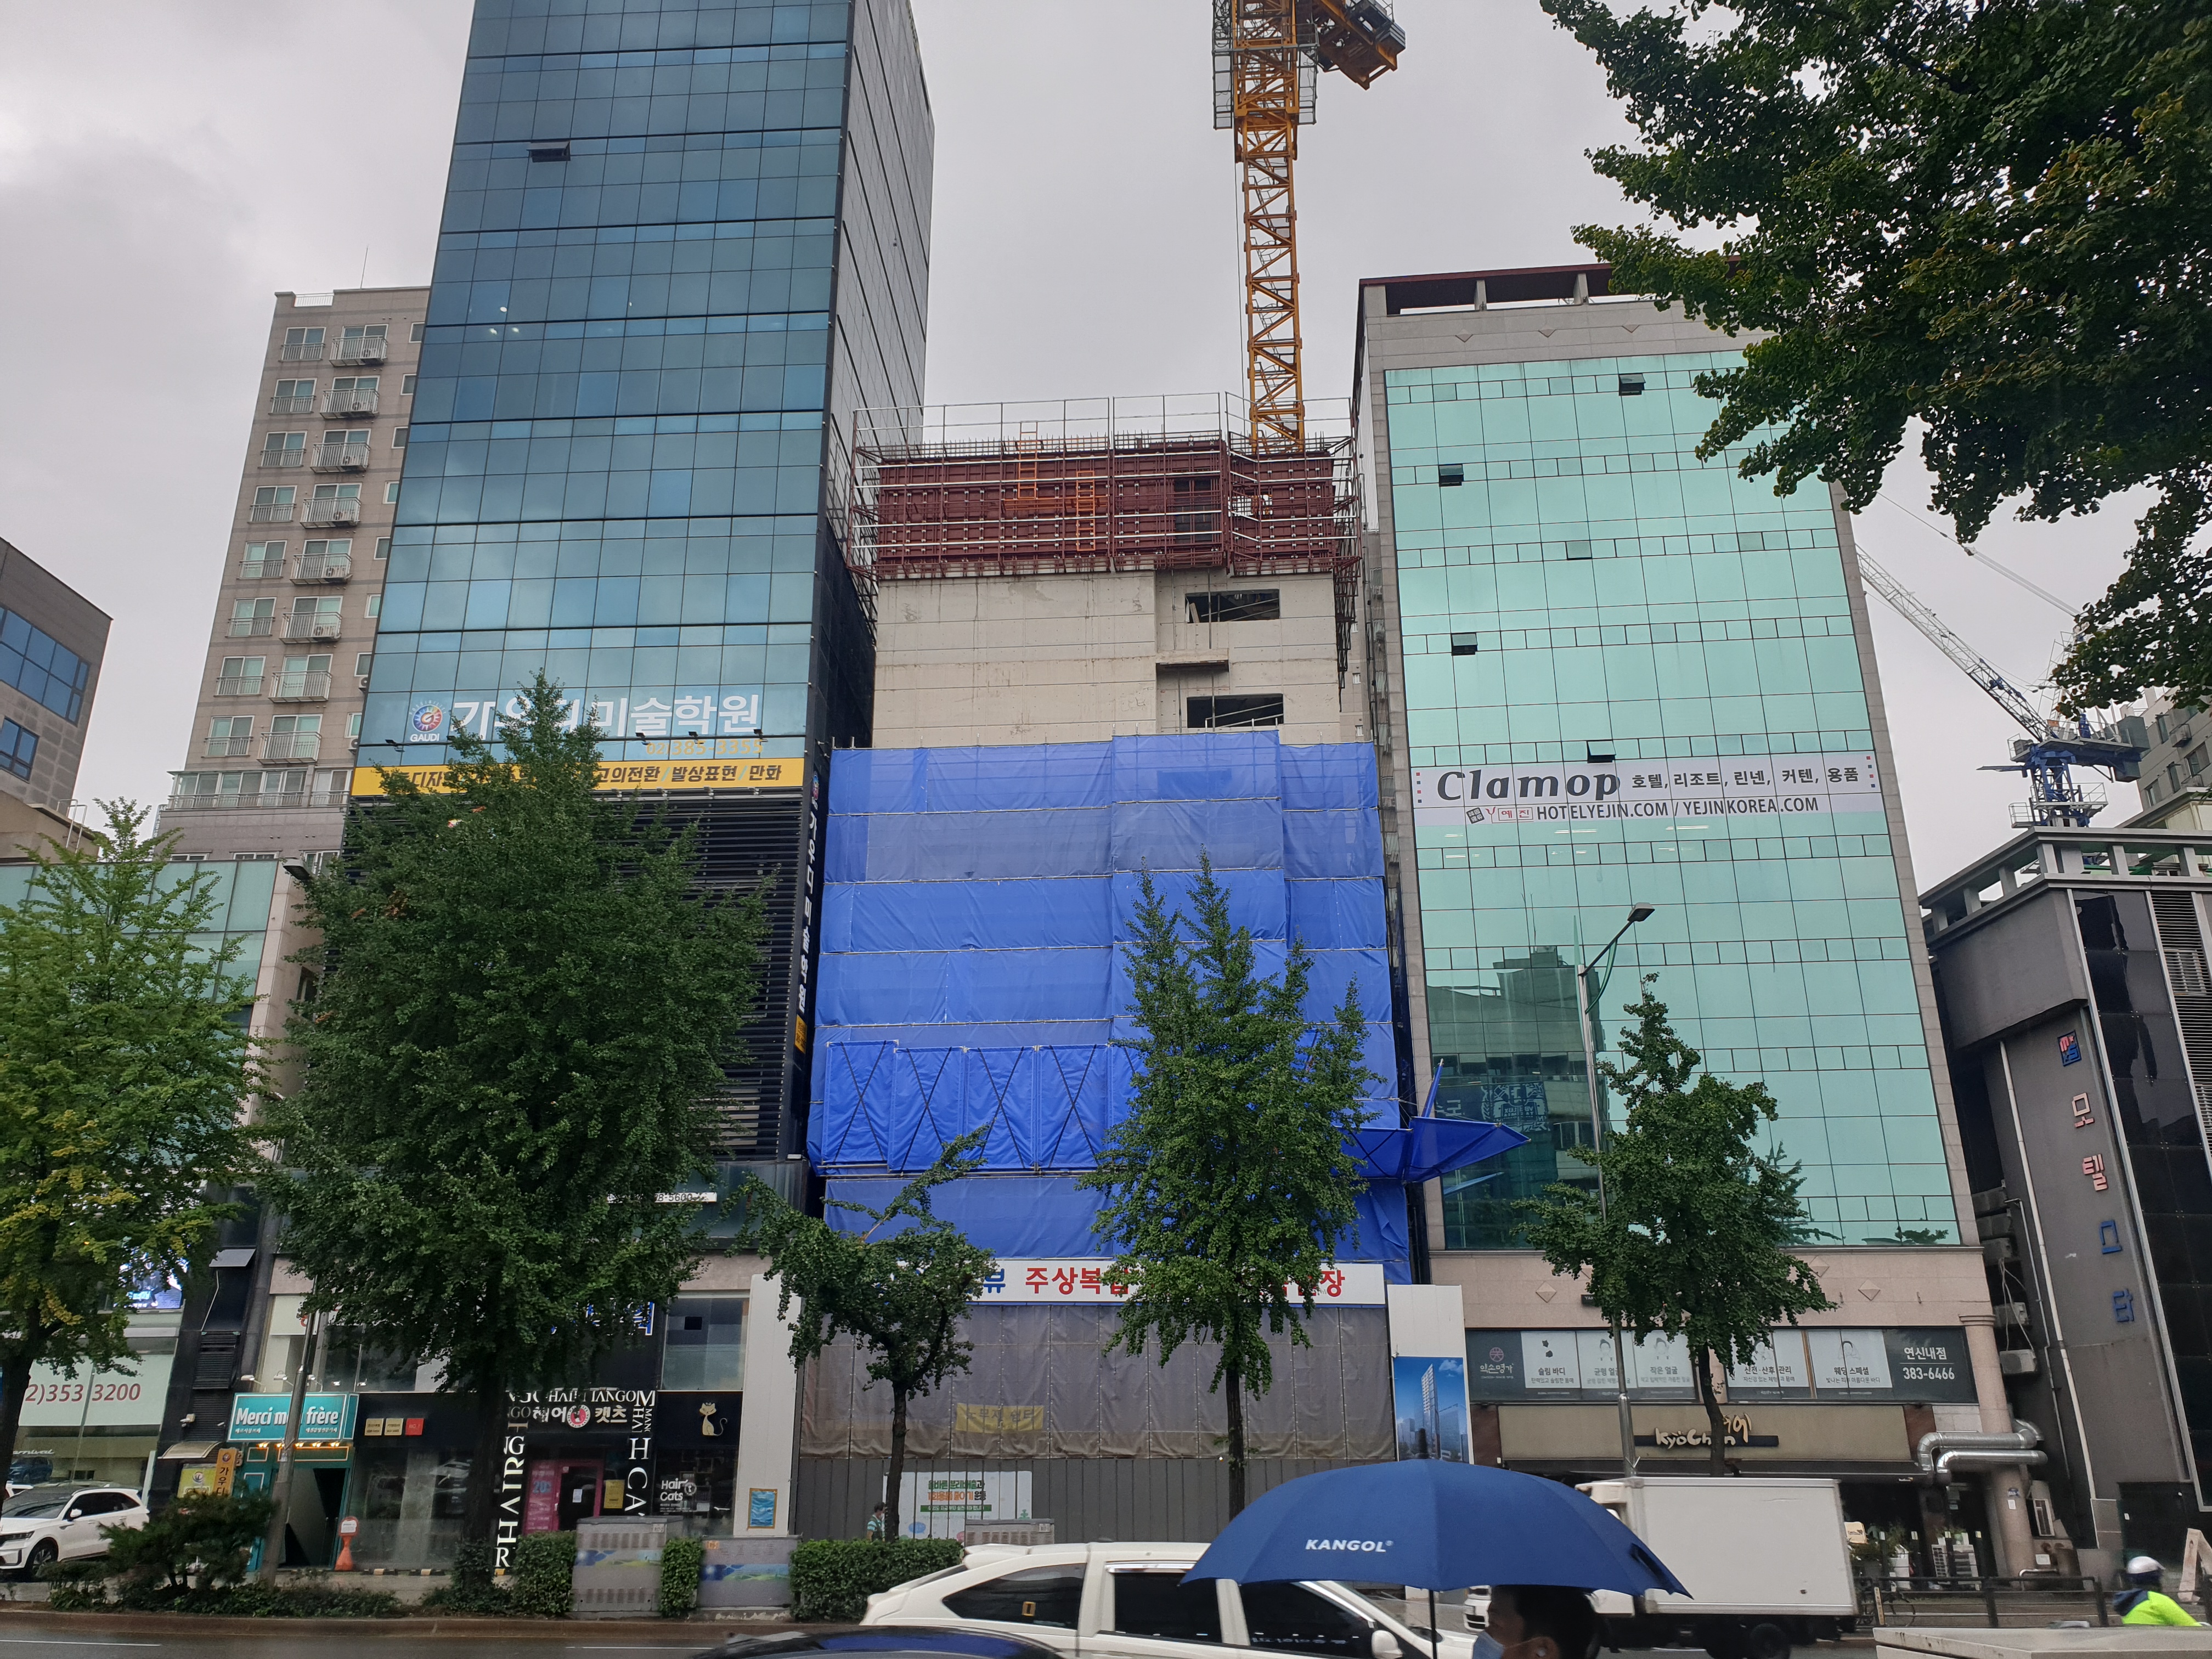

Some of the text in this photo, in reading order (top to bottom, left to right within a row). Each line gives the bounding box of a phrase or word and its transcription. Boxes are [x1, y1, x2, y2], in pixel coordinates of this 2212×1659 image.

[410, 733, 440, 742] GAUDI
[600, 764, 782, 783] 고의전환 발상표현 만화
[1632, 768, 1859, 789] 호텔, 리조트, 린넨, 커텐, 용품
[1437, 769, 1620, 801] Clamop
[1501, 810, 1530, 819] 예진
[1537, 803, 1668, 820] HOTELYEJIN.COM
[1683, 797, 1819, 815] YEJINKOREA.COM
[2072, 1092, 2108, 1191] 모텔
[1904, 1347, 1947, 1360] 연신내점
[1538, 1367, 1565, 1376] 슬림 바디
[1650, 1367, 1678, 1375] 작은 얼굴
[1903, 1367, 1955, 1380] 383-6466
[92, 1384, 140, 1401] 3200
[235, 1407, 273, 1425] Merci
[306, 1406, 338, 1425] frère
[595, 1405, 628, 1423] 캣츠
[661, 1477, 689, 1489] Hair
[660, 1491, 684, 1501] Cats
[1305, 1539, 1386, 1553] KANGOL
